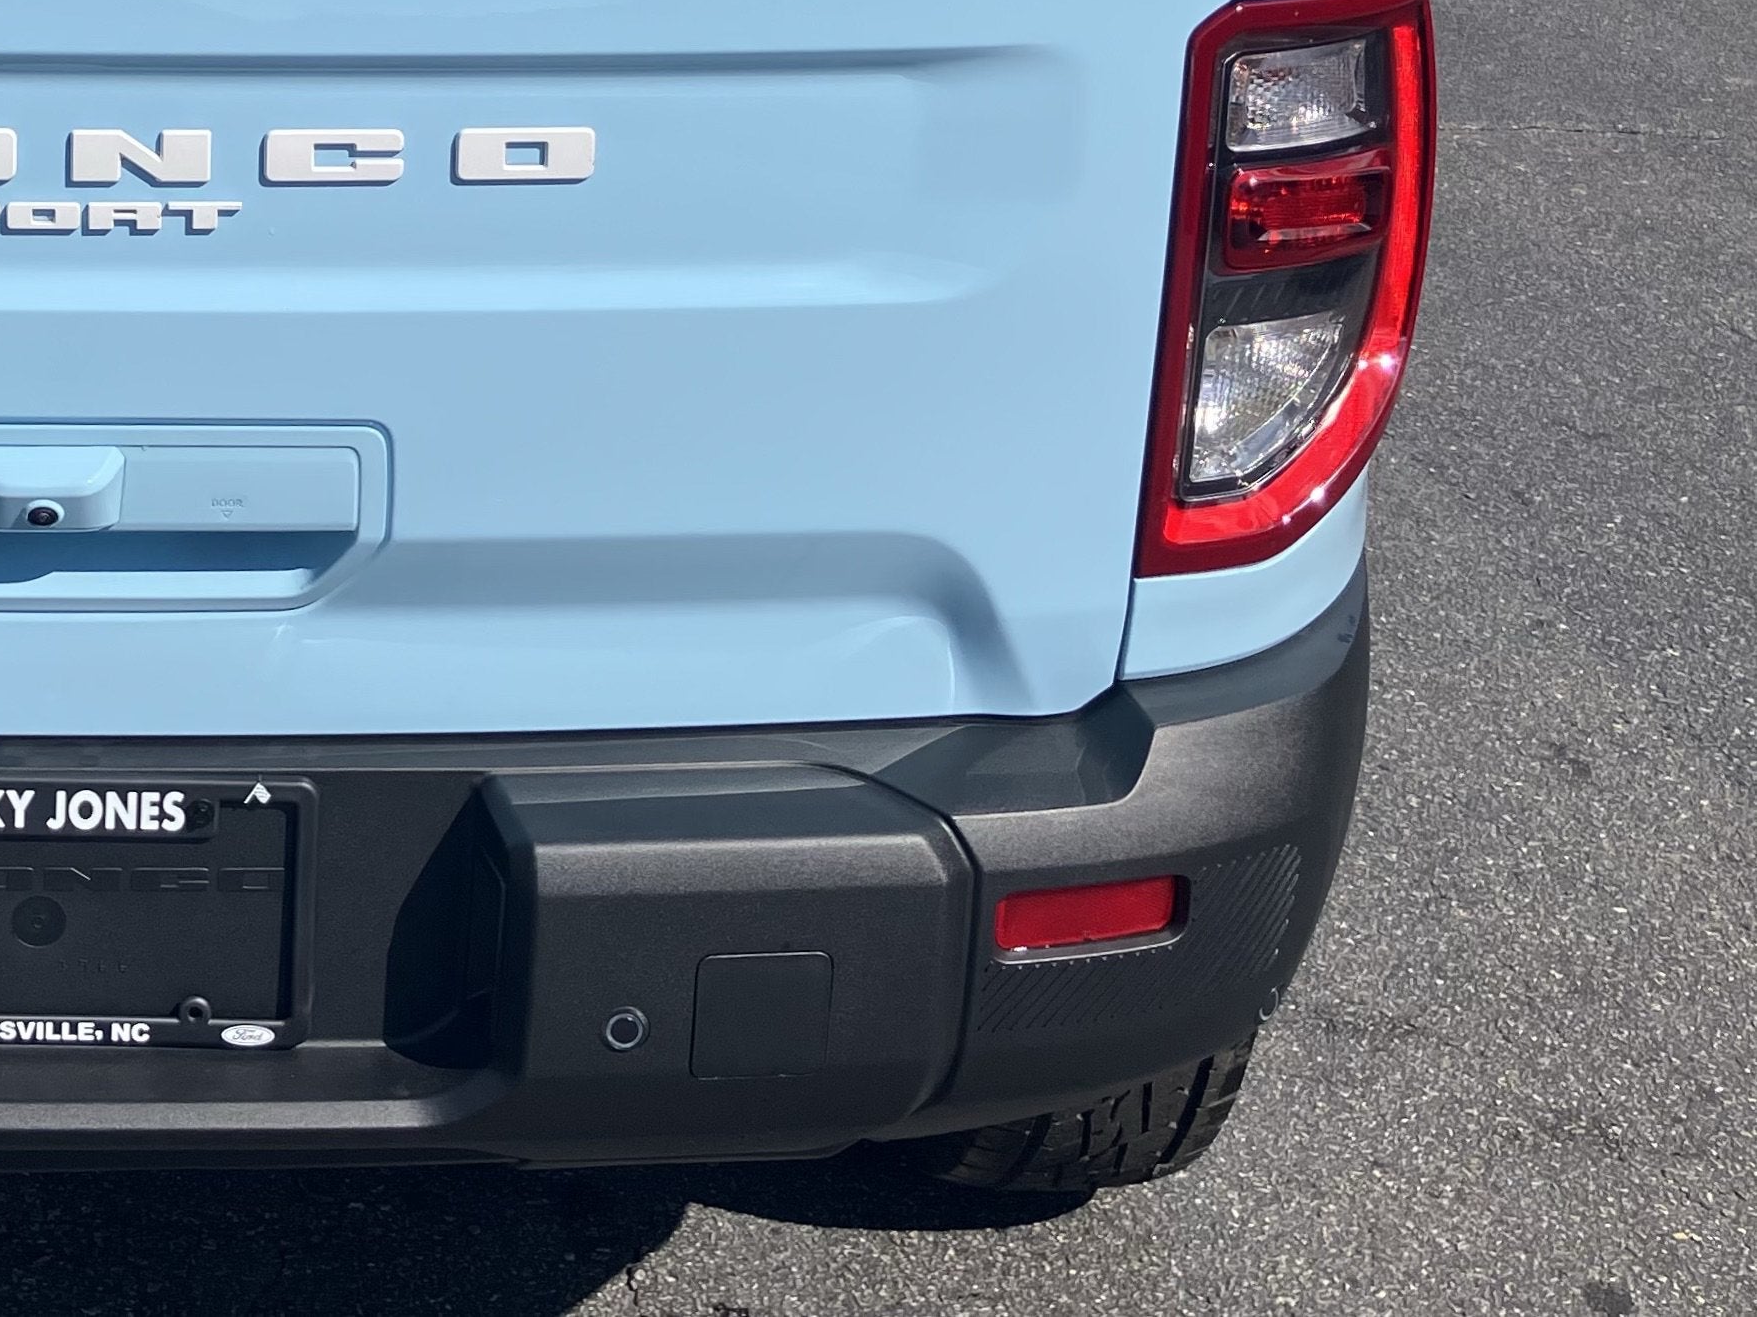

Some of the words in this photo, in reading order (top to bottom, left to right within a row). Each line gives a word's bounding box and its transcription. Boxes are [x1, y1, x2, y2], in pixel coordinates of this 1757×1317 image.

[46, 789, 186, 831] JONES
[111, 1022, 150, 1042] NC
[232, 1028, 265, 1041] Ford
